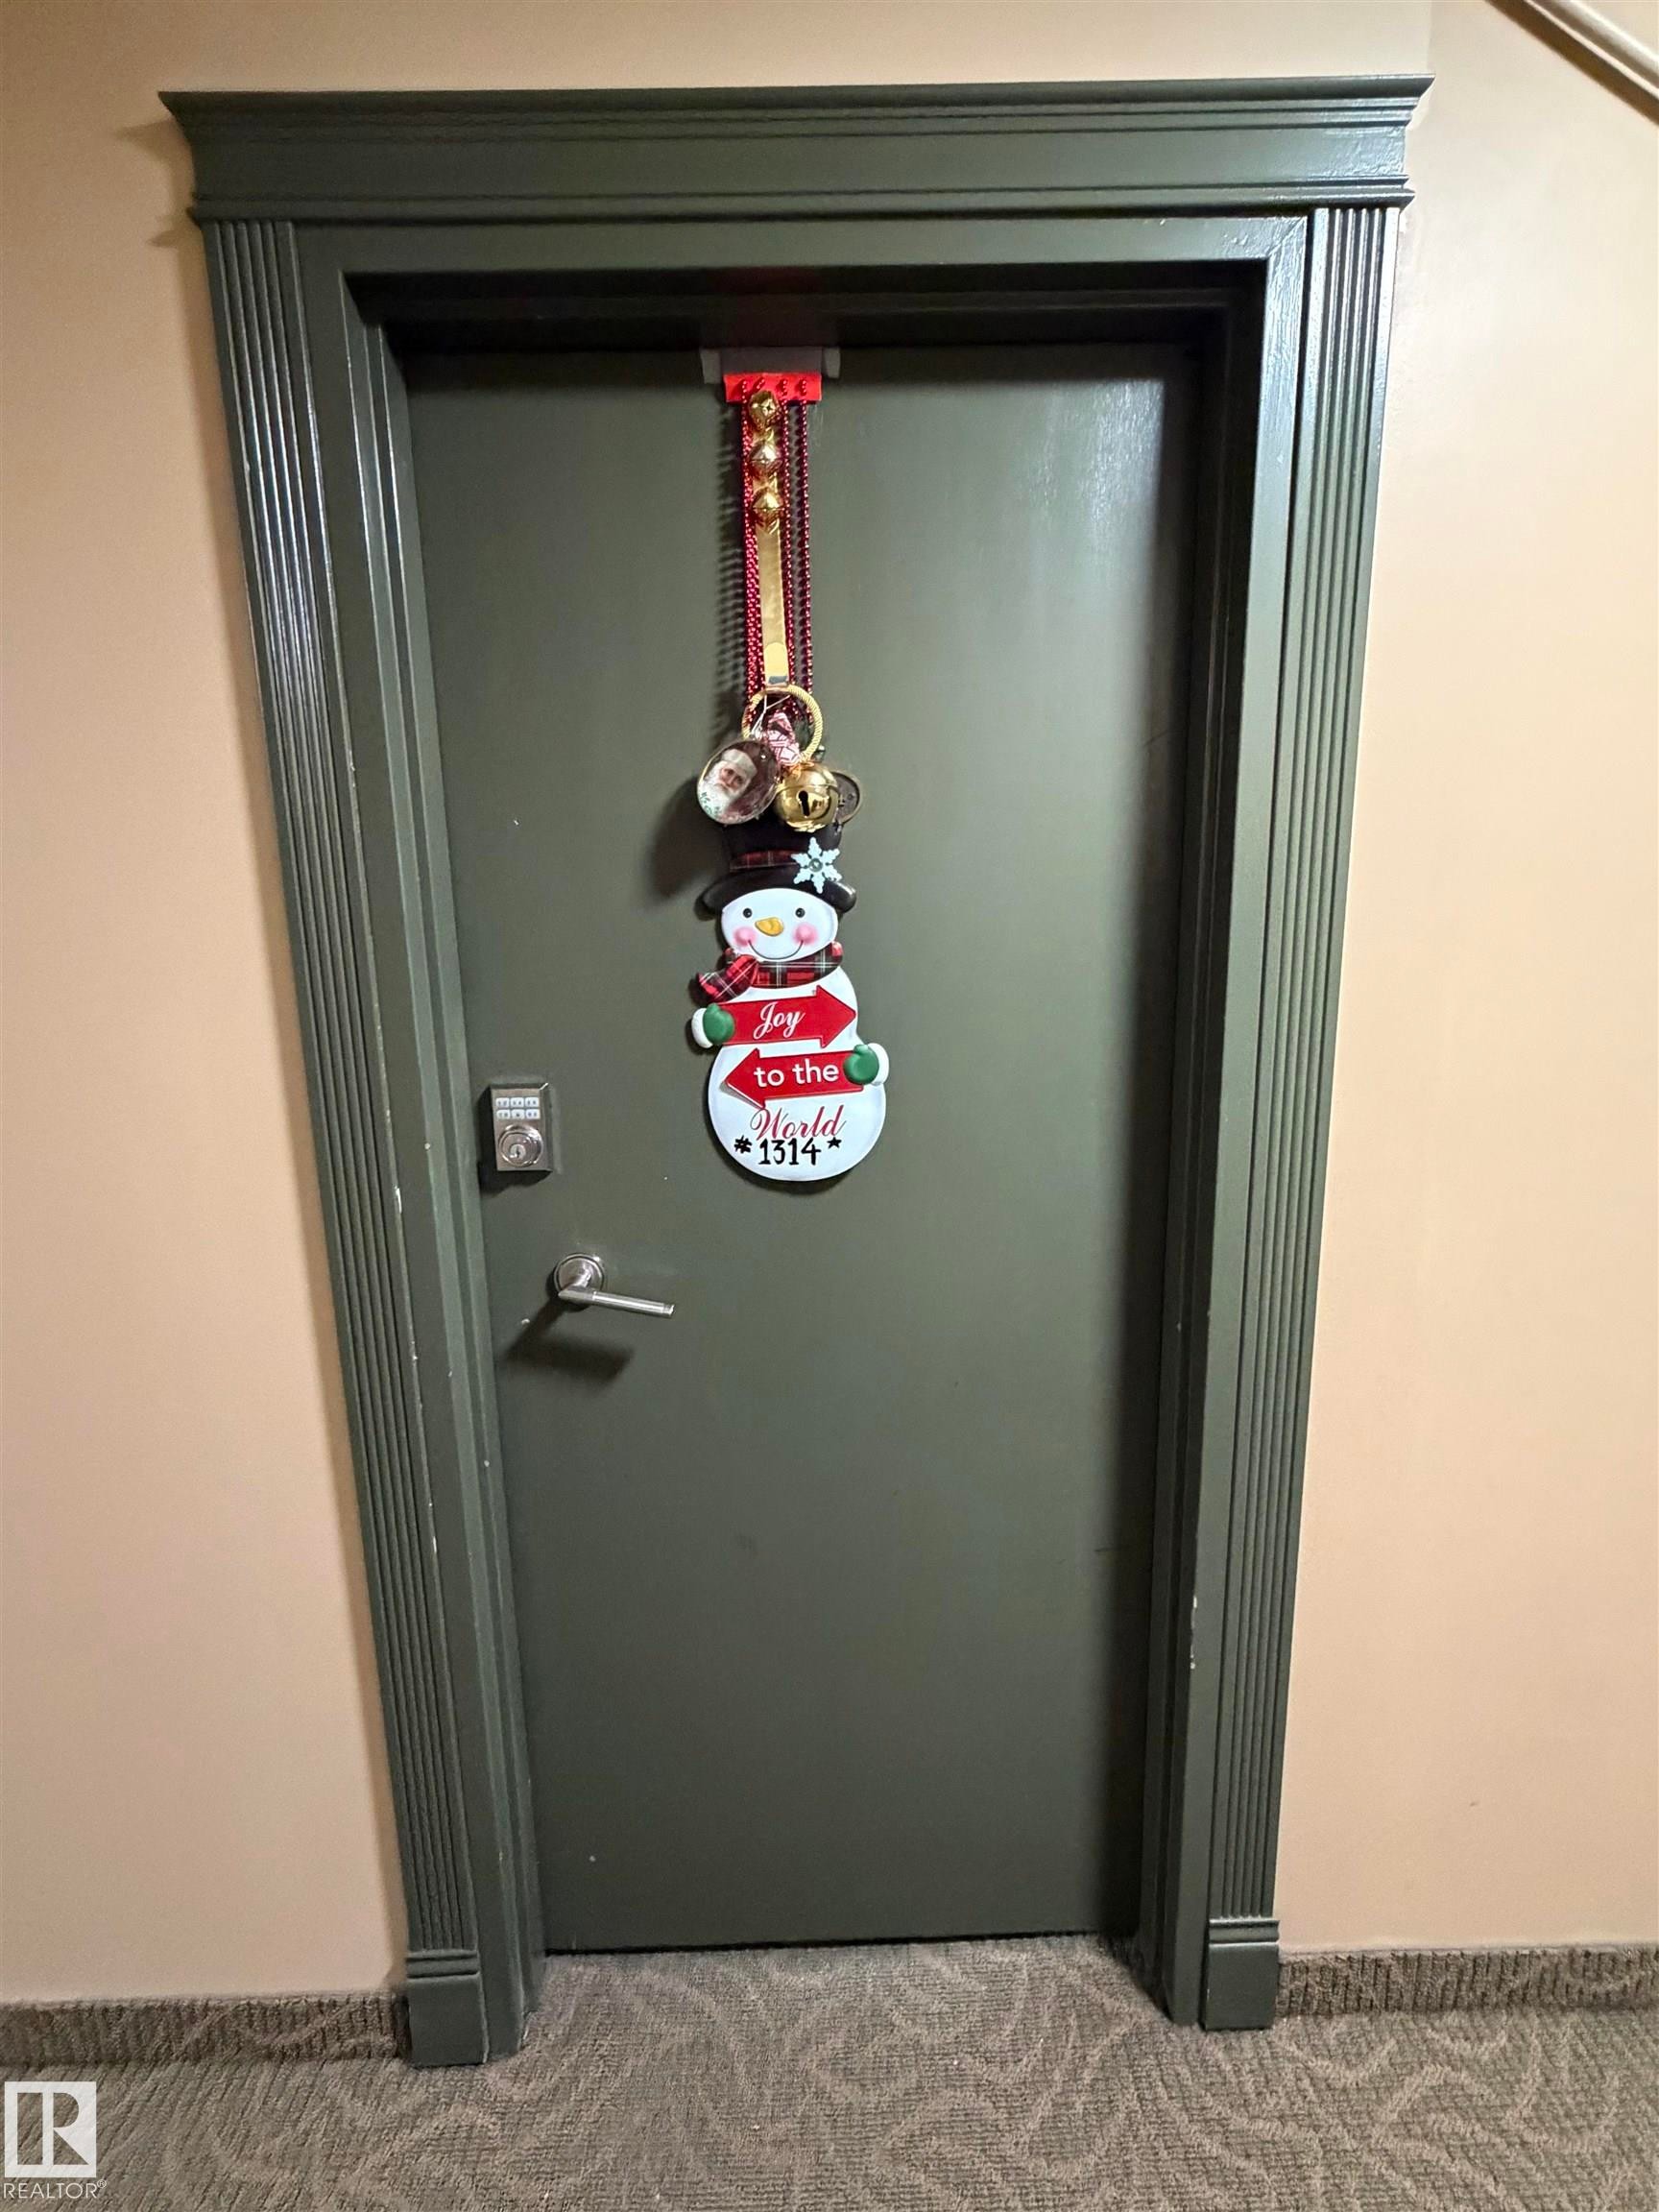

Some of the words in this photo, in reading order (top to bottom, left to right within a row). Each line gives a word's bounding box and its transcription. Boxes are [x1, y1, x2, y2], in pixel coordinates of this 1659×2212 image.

[754, 1001, 805, 1039] Joy
[754, 1069, 785, 1088] to
[792, 1059, 839, 1085] the
[750, 1104, 847, 1141] World
